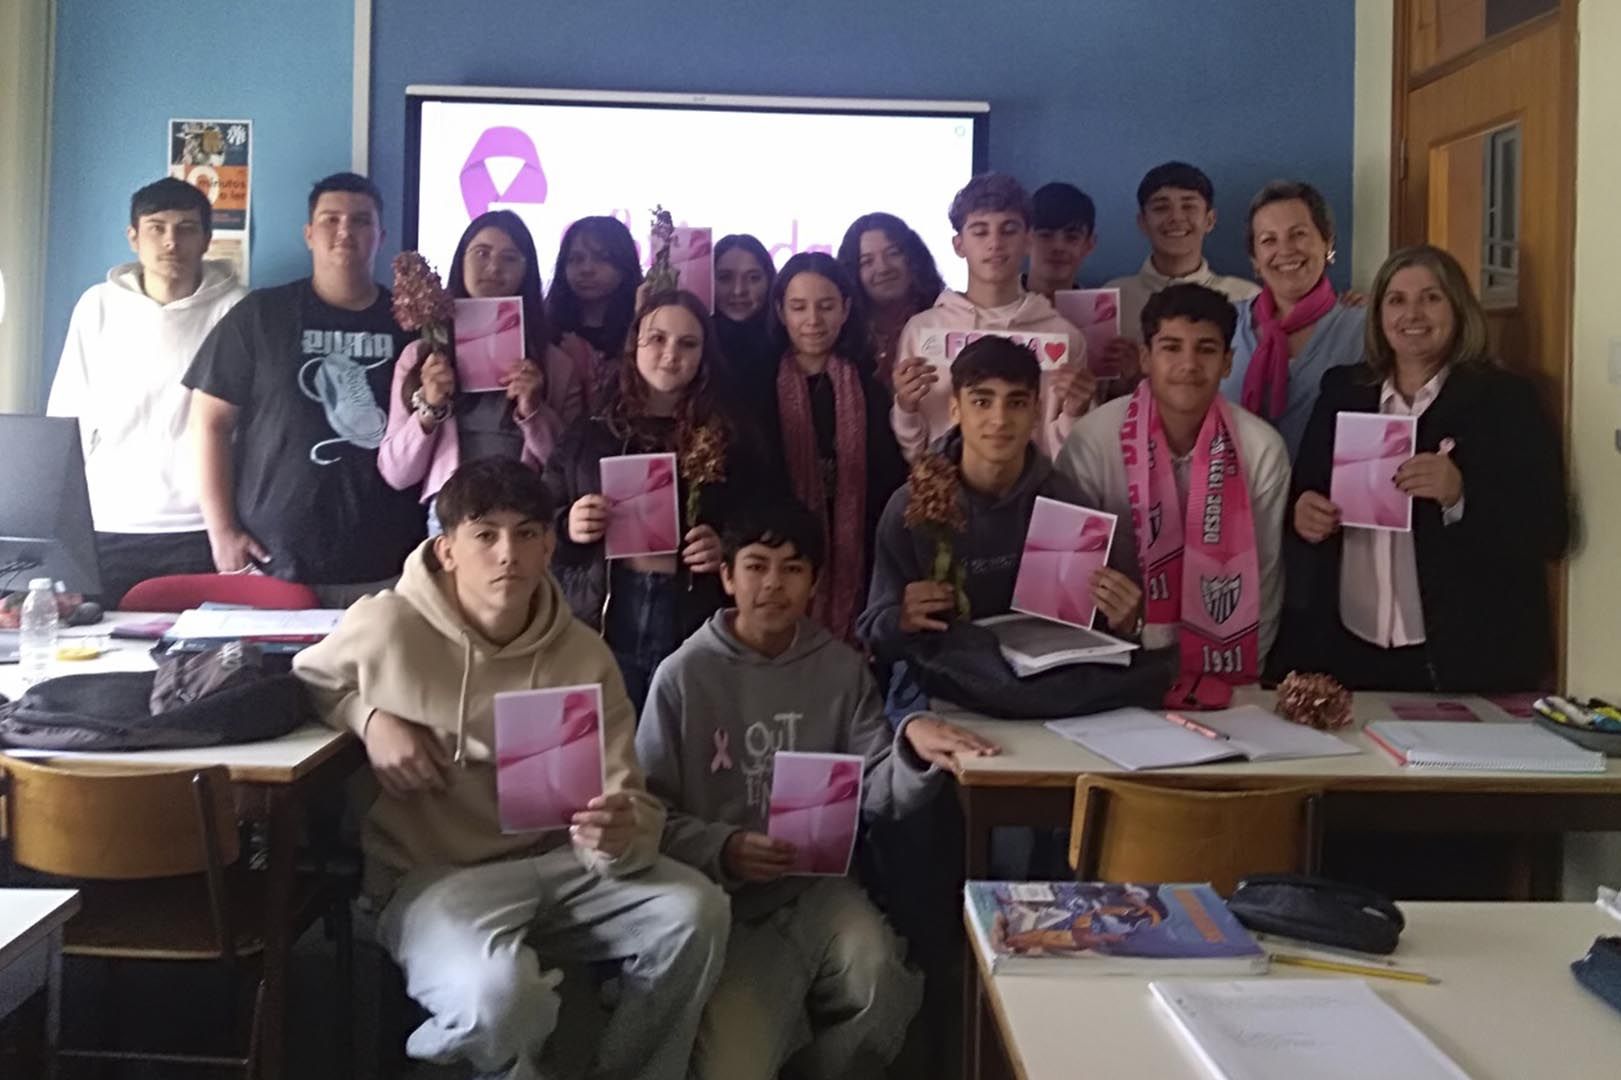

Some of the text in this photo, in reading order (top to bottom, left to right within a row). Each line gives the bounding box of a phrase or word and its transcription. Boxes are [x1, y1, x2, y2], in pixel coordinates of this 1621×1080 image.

[1207, 458, 1224, 490] 1931
[1203, 495, 1223, 544] DESDE
[1202, 645, 1243, 673] 1931
